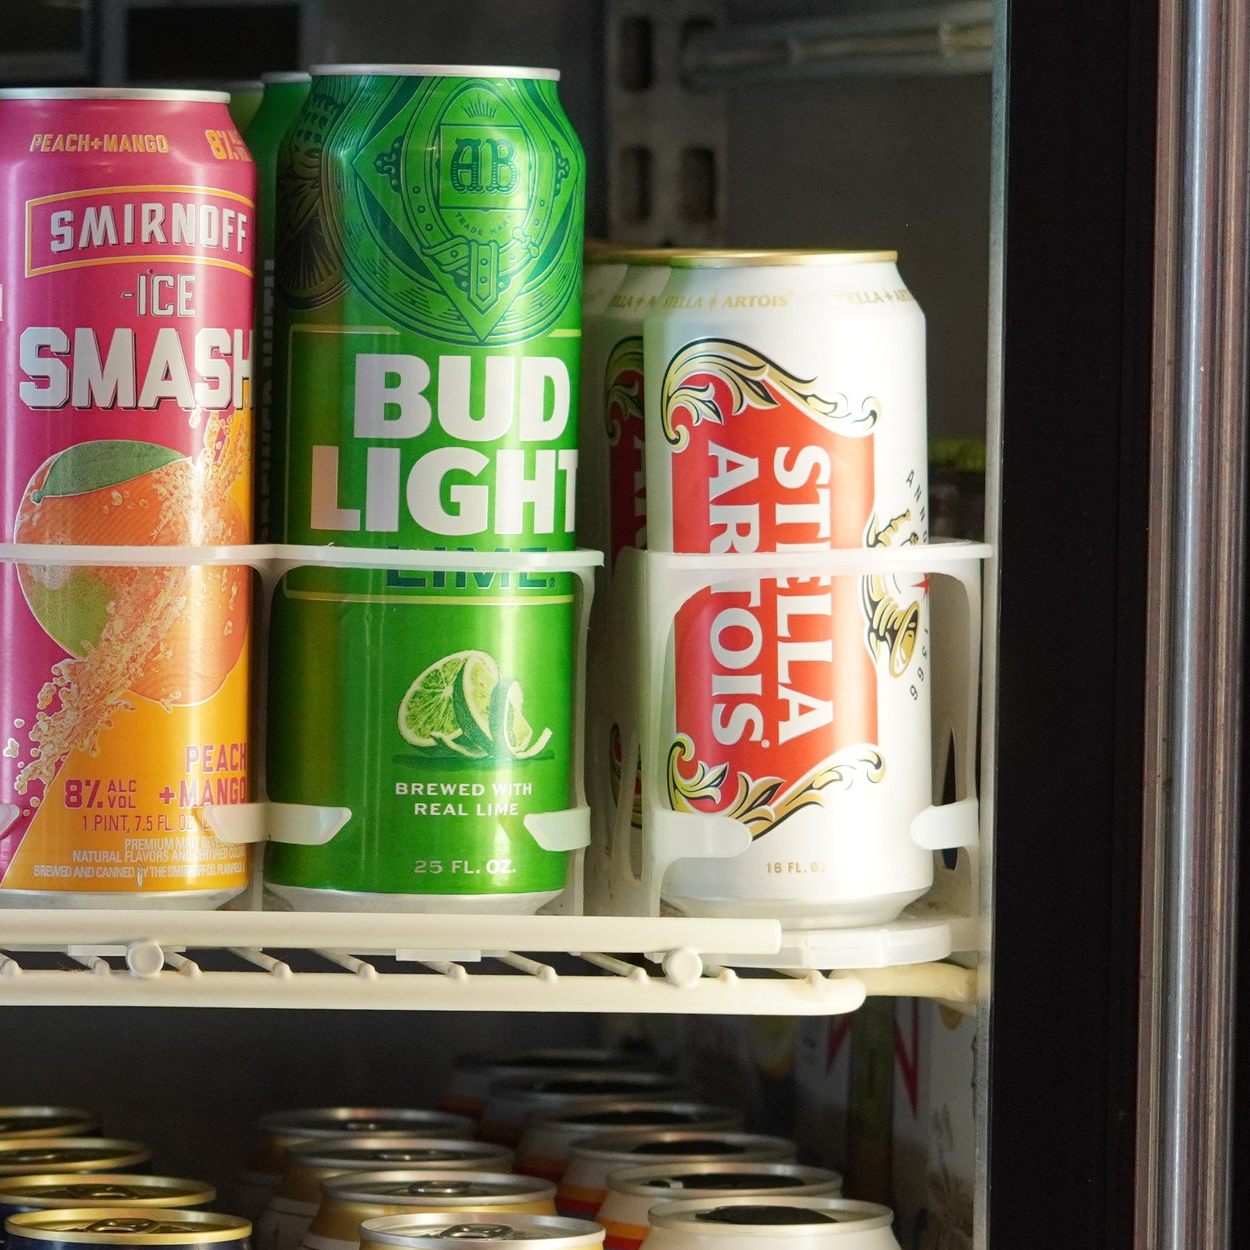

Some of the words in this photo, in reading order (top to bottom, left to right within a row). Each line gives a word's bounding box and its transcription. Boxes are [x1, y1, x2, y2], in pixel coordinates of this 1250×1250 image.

[30, 134, 169, 153] PEACH+MANGO
[450, 138, 519, 194] AB
[50, 203, 248, 253] SMIRNOFF
[454, 211, 484, 236] TRADE
[722, 295, 789, 309] ARTOIS
[20, 327, 253, 411] SMASH
[353, 353, 571, 442] BUD
[310, 445, 579, 537] LIGHT
[185, 742, 247, 774] PEACH
[64, 779, 104, 809] 8%
[107, 780, 137, 793] ALC
[395, 782, 485, 796] BREWED
[492, 783, 532, 796] WITH
[108, 795, 137, 809] VOL
[414, 803, 469, 816] REAL
[476, 803, 519, 817] LIME
[134, 815, 154, 832] 7.5
[124, 839, 173, 851] PREMIUM
[72, 851, 122, 863] NATURAL
[124, 850, 169, 863] FLAVORS
[414, 860, 443, 874] 25
[451, 860, 481, 874] FL.
[486, 860, 517, 874] OZ.
[766, 862, 782, 875] 16
